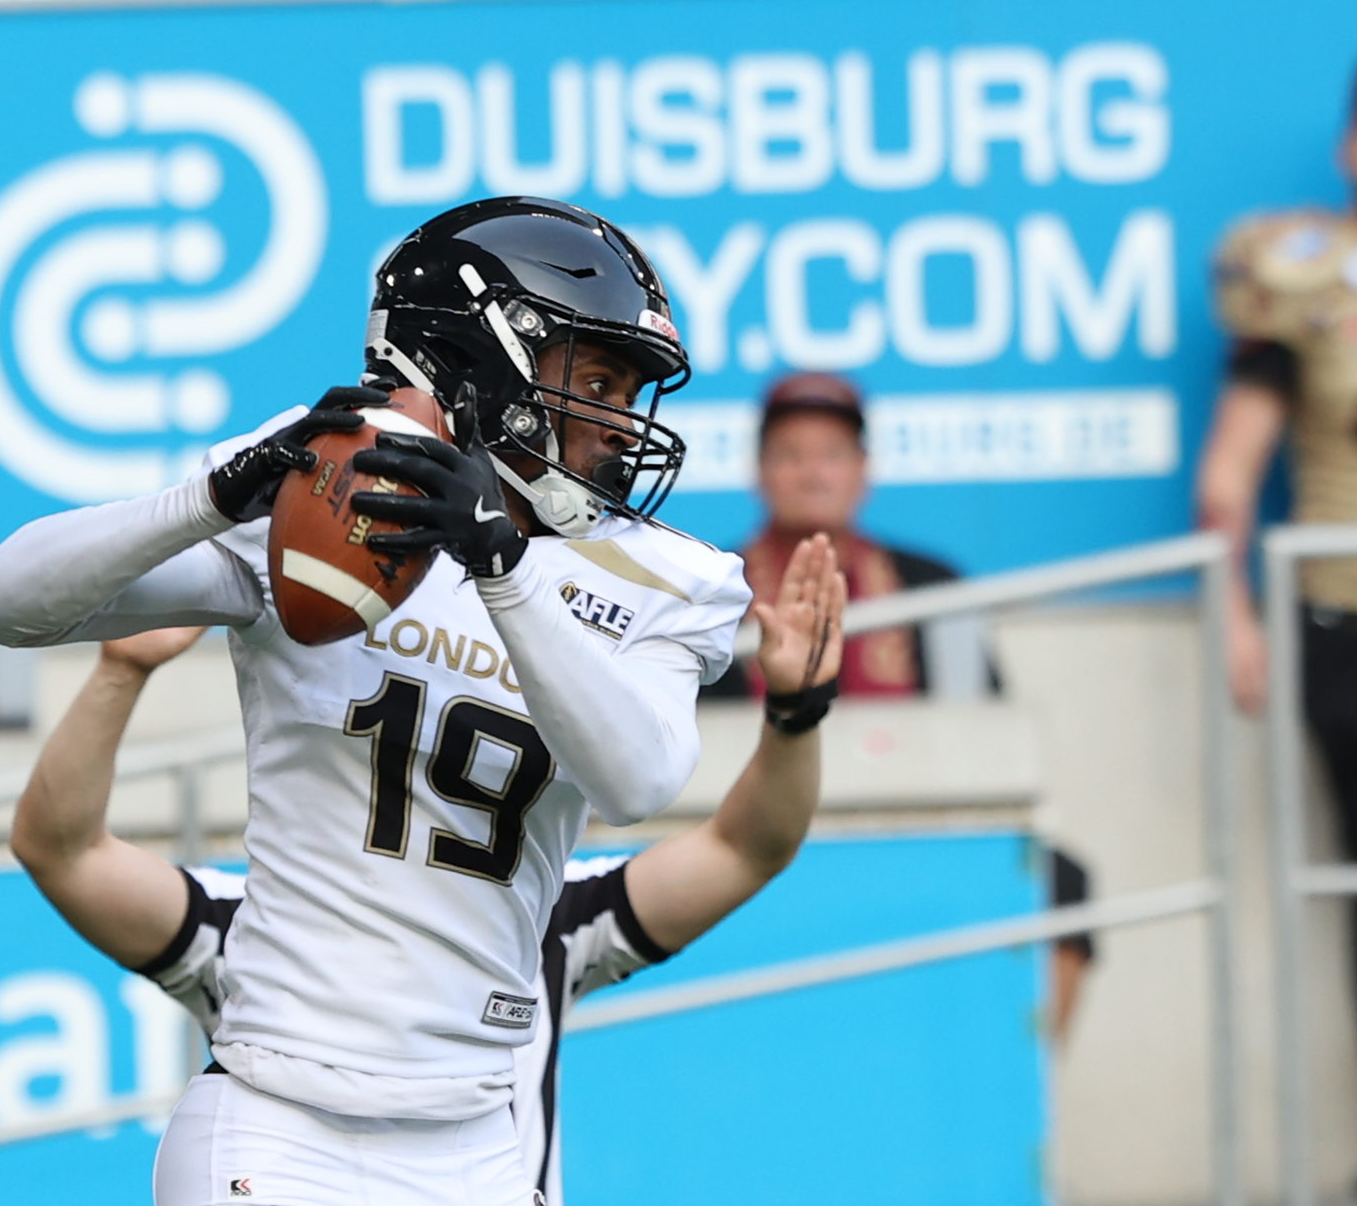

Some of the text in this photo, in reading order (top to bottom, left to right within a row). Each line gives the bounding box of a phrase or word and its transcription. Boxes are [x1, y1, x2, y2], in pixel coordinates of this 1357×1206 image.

[361, 40, 1171, 205] DUISBURG
[650, 208, 1179, 375] Y.COM
[568, 588, 634, 636] AFLE
[344, 669, 557, 887] 19
